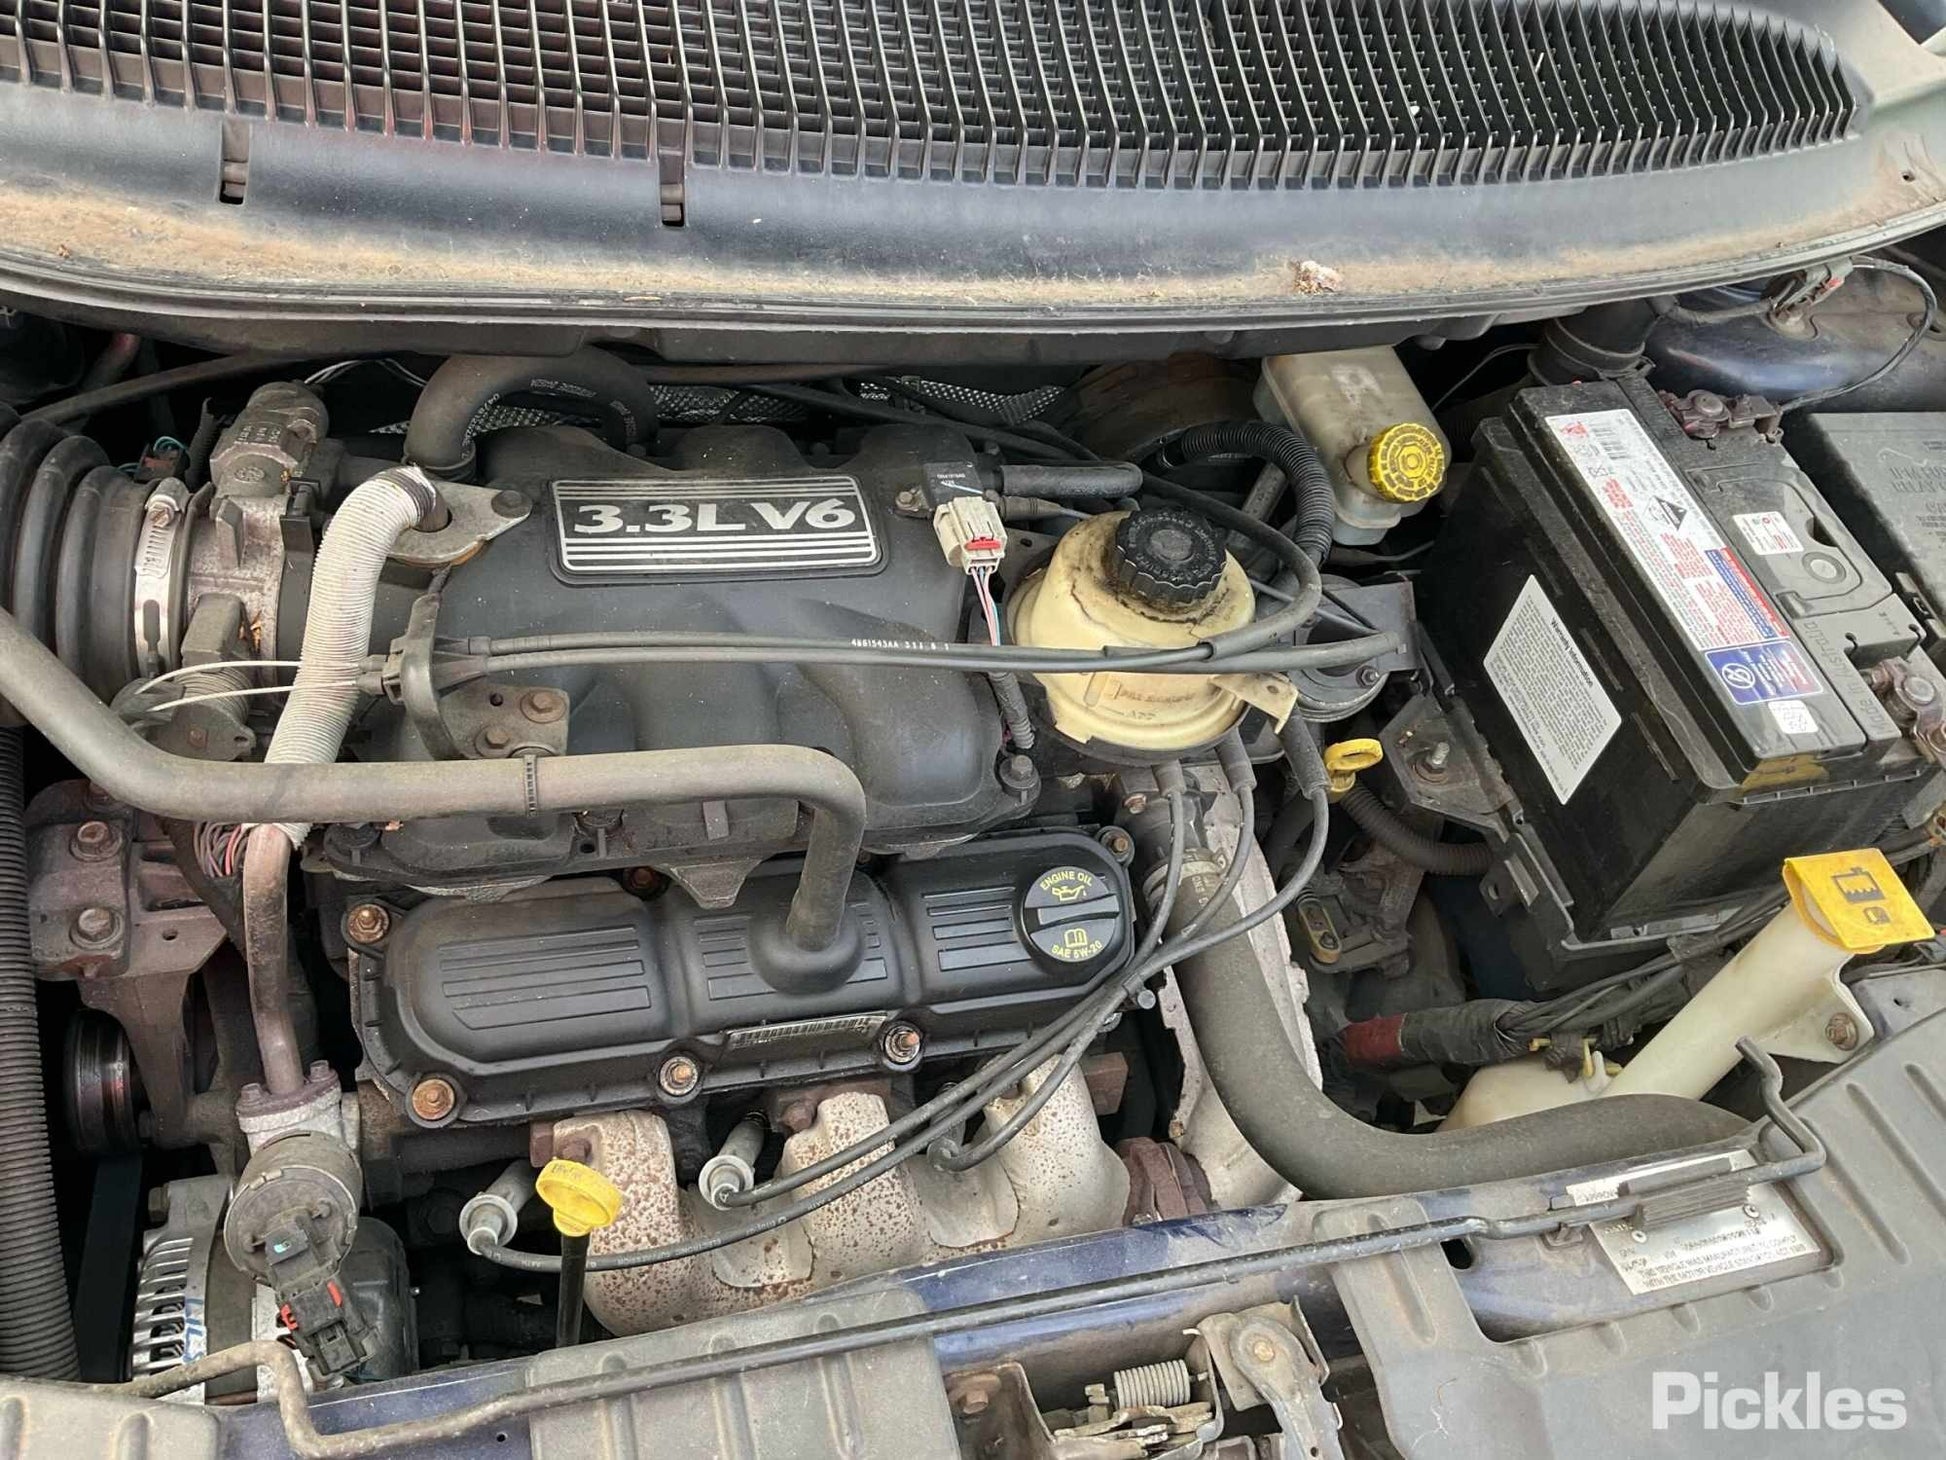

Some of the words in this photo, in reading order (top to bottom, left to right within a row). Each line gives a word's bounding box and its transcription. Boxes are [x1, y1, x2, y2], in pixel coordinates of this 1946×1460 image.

[574, 503, 746, 534] 3.3L
[751, 498, 856, 530] V6
[1040, 870, 1076, 890] ENGINE
[1077, 872, 1094, 887] OIL
[1052, 945, 1071, 958] SAE
[1073, 940, 1103, 959] 5W-20
